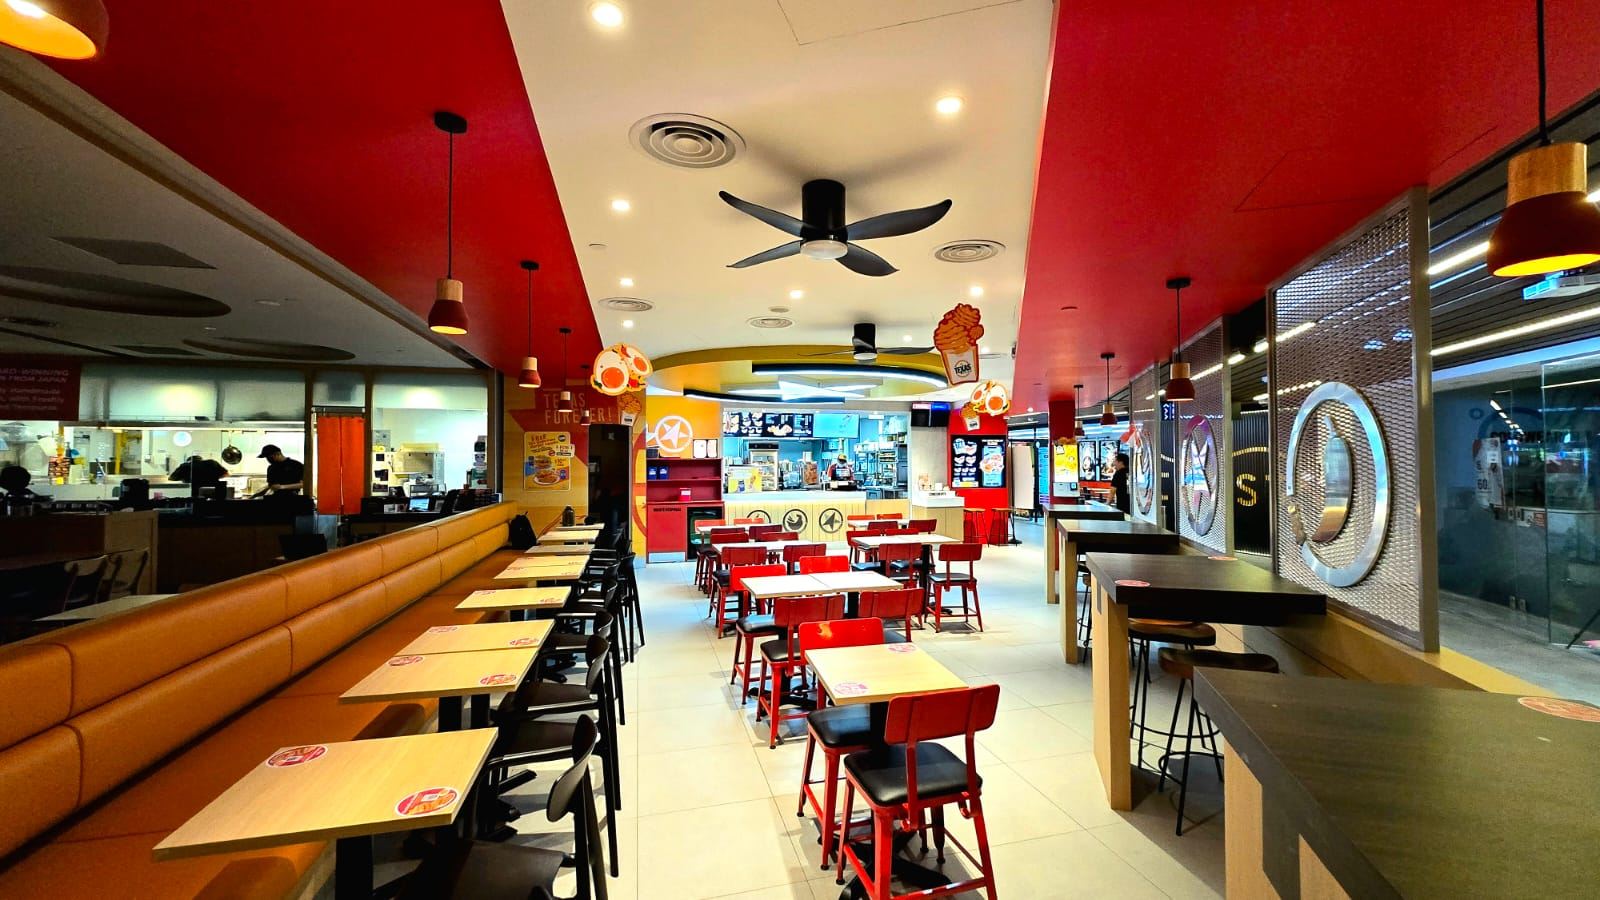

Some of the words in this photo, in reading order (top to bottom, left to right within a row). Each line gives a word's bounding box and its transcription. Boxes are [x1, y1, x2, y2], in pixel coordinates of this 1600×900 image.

[954, 363, 972, 375] TEXAS
[544, 392, 586, 409] TEAS
[545, 407, 612, 424] FOREER!
